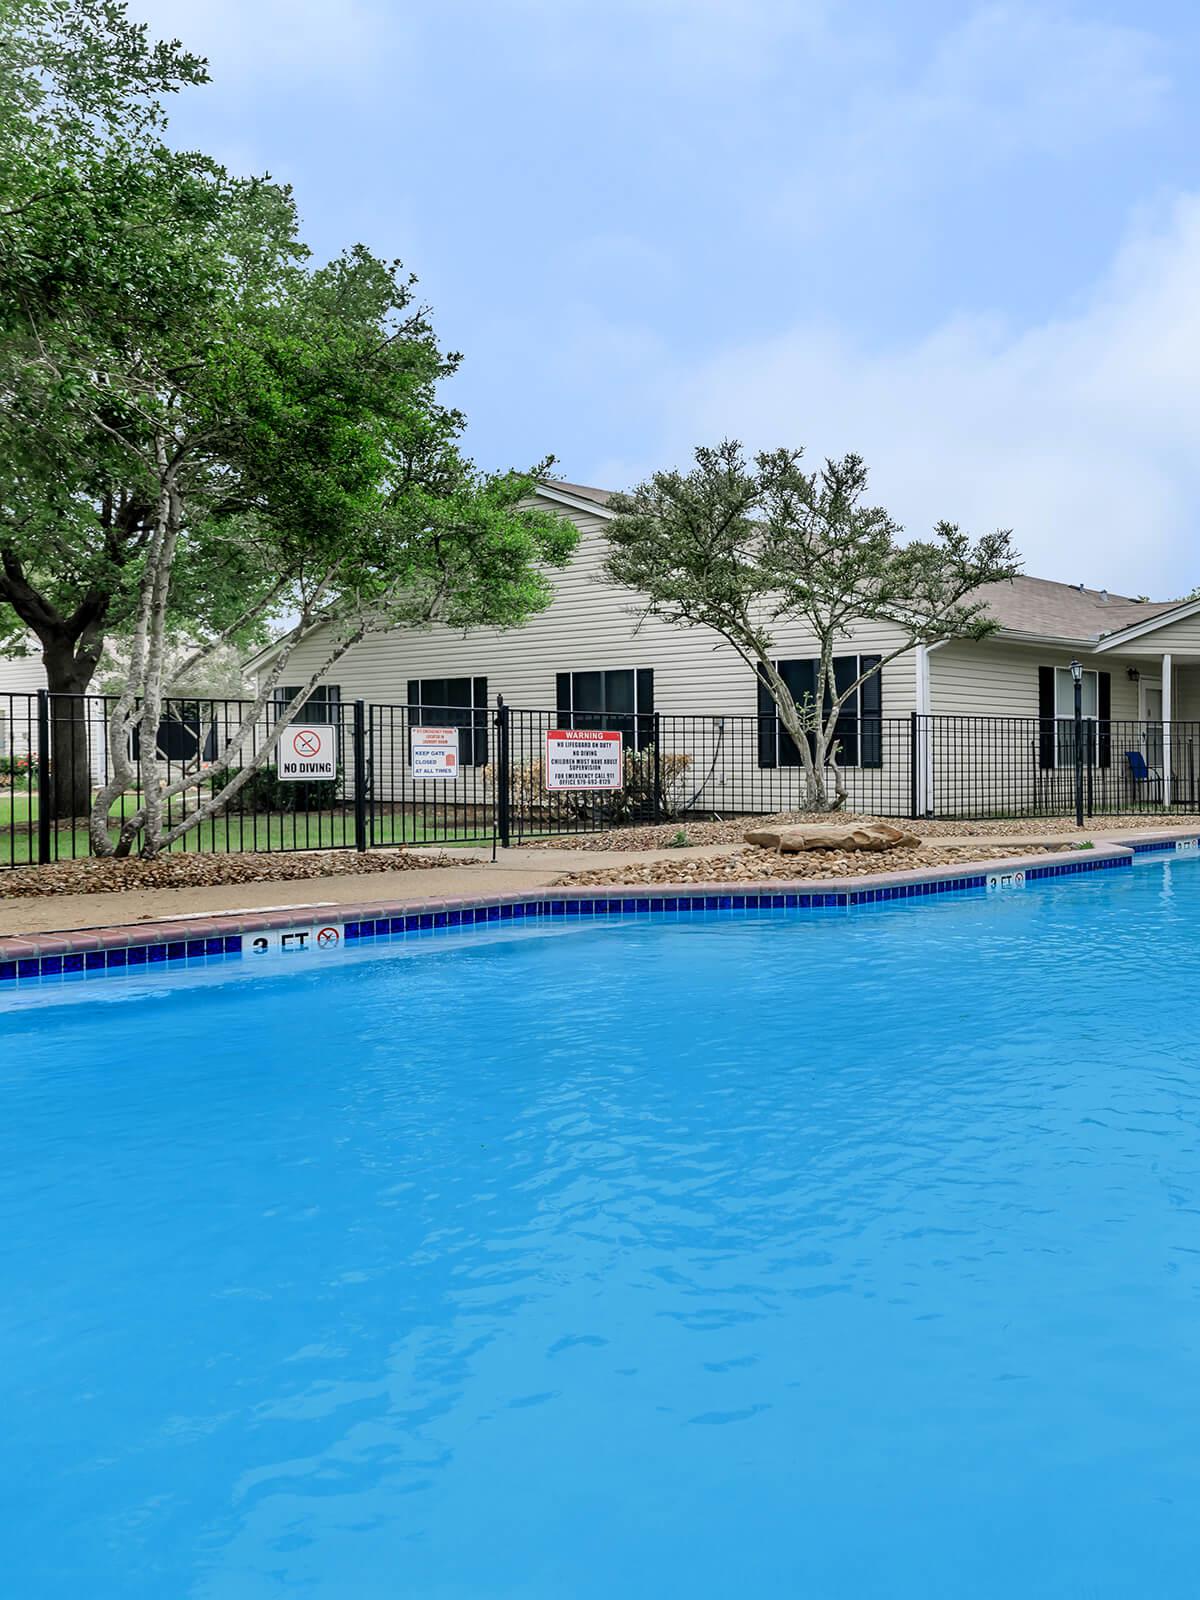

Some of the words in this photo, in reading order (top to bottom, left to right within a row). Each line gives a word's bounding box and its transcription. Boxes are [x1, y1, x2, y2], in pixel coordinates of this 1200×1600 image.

[284, 763, 297, 773] NO
[299, 763, 331, 773] DIVING
[990, 878, 997, 889] 3
[1001, 876, 1012, 888] FT
[252, 937, 269, 953] 3
[281, 932, 309, 950] FT
